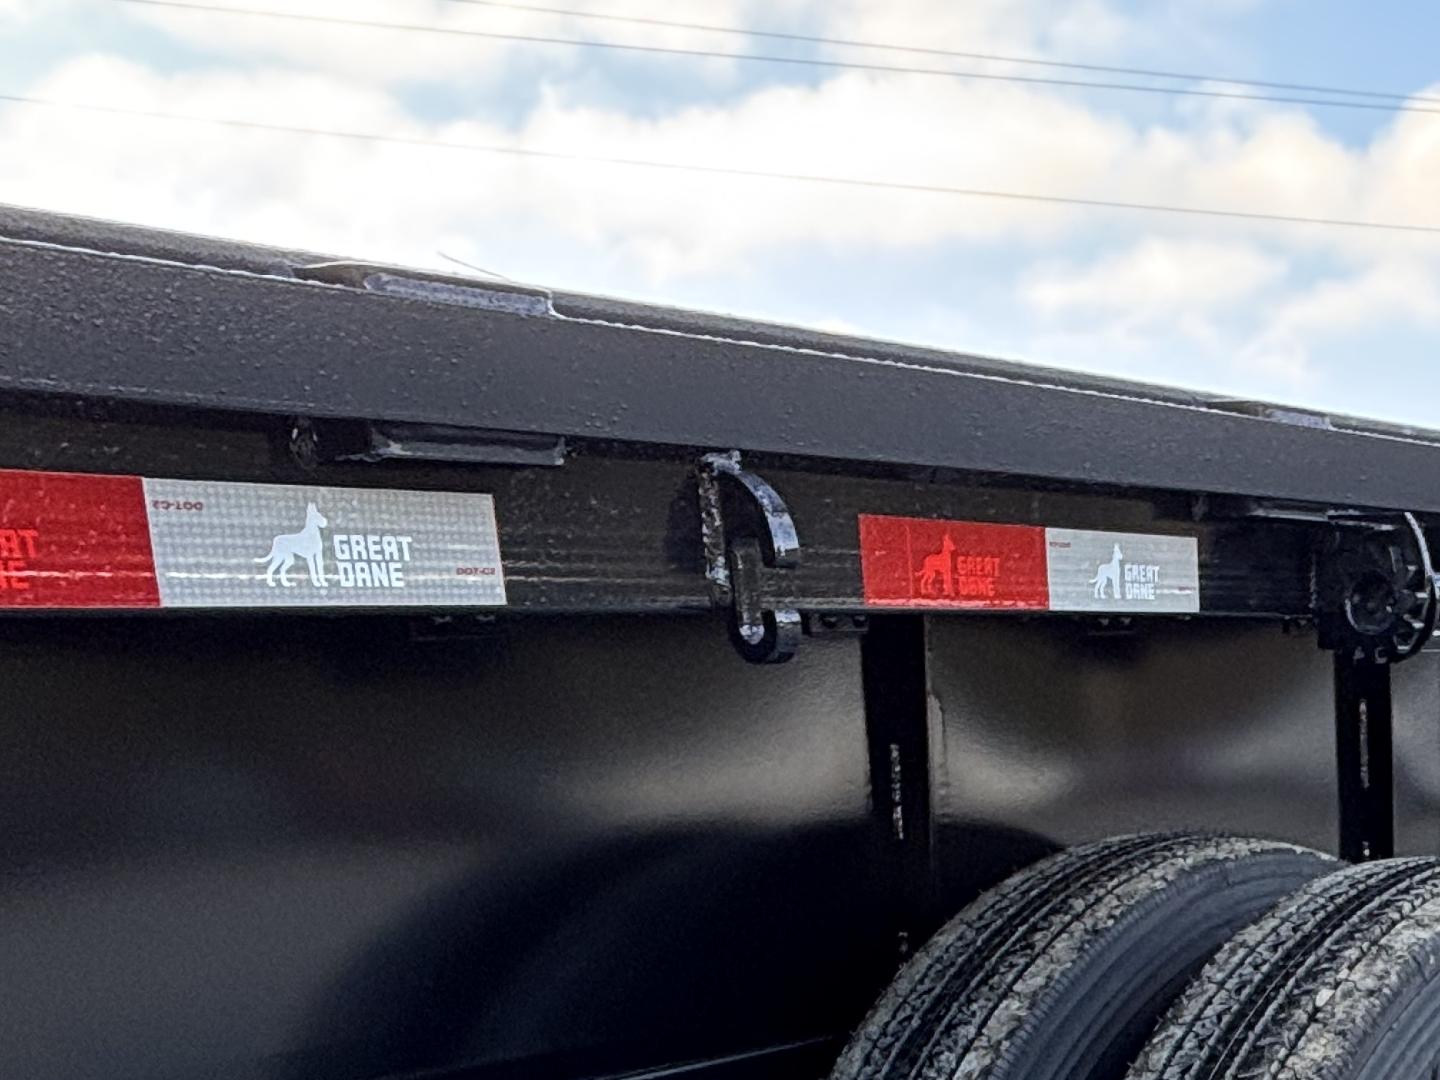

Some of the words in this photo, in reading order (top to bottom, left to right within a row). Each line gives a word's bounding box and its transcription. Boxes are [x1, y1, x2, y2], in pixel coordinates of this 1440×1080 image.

[153, 501, 204, 511] DOT-C2
[333, 534, 412, 561] GREAT
[337, 561, 405, 588] DANE
[957, 556, 1000, 577] GREAT
[1124, 564, 1160, 583] GREAT
[957, 576, 996, 597] DANE
[1125, 582, 1156, 600] DANE
